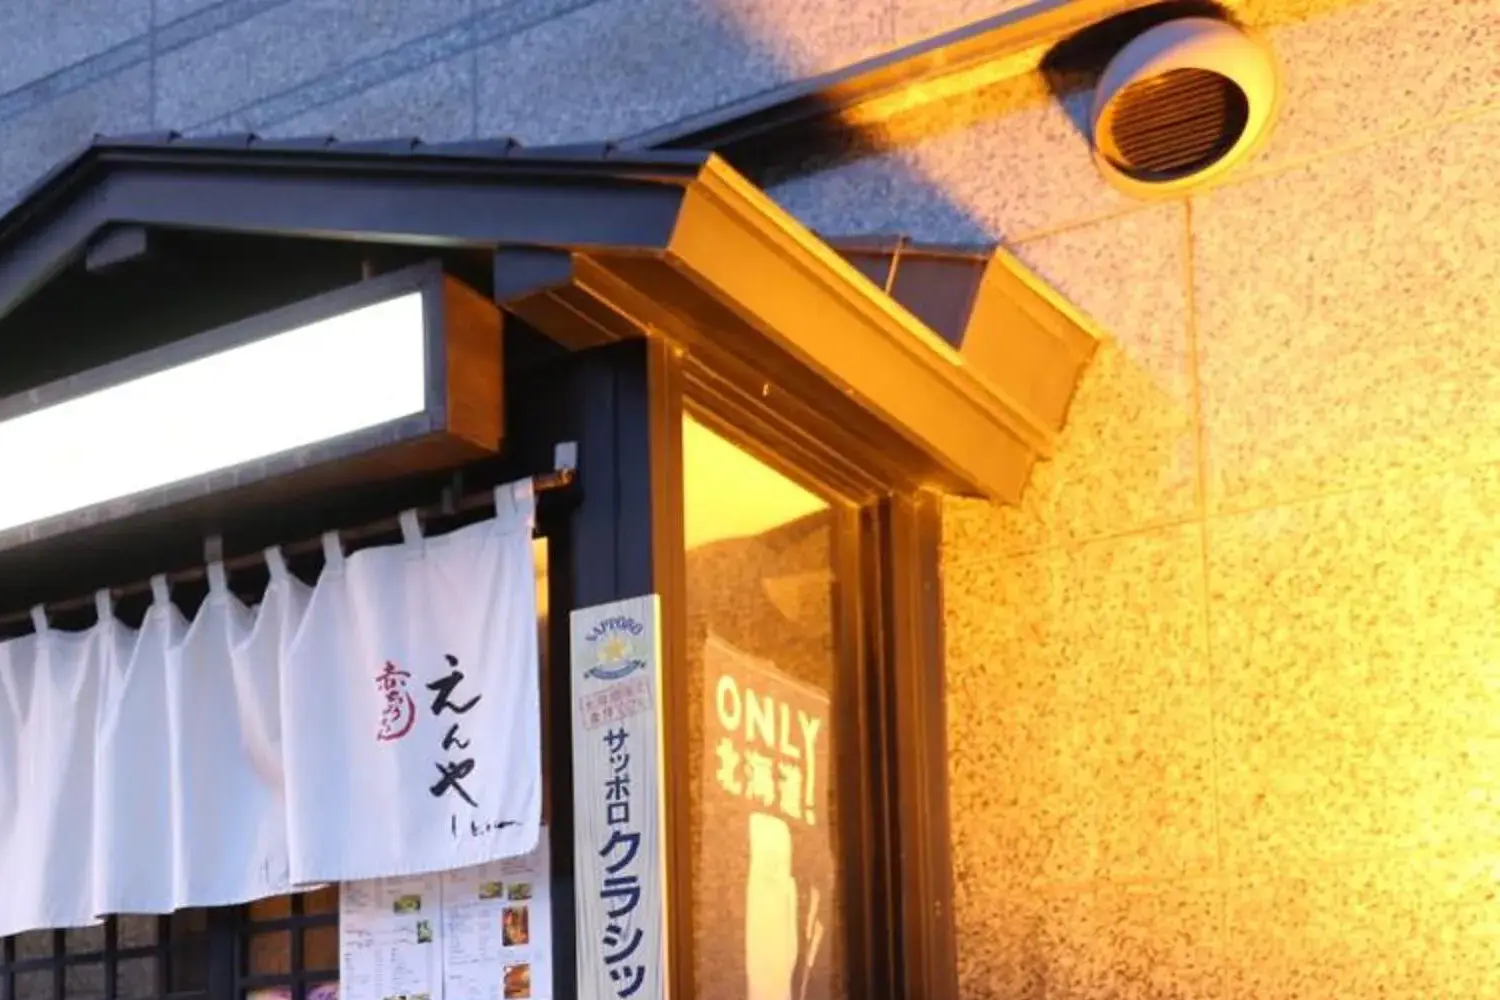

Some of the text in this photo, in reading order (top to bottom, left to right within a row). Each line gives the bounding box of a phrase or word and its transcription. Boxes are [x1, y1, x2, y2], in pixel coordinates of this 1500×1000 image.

[425, 653, 482, 808] えんや
[715, 674, 821, 770] ONLY
